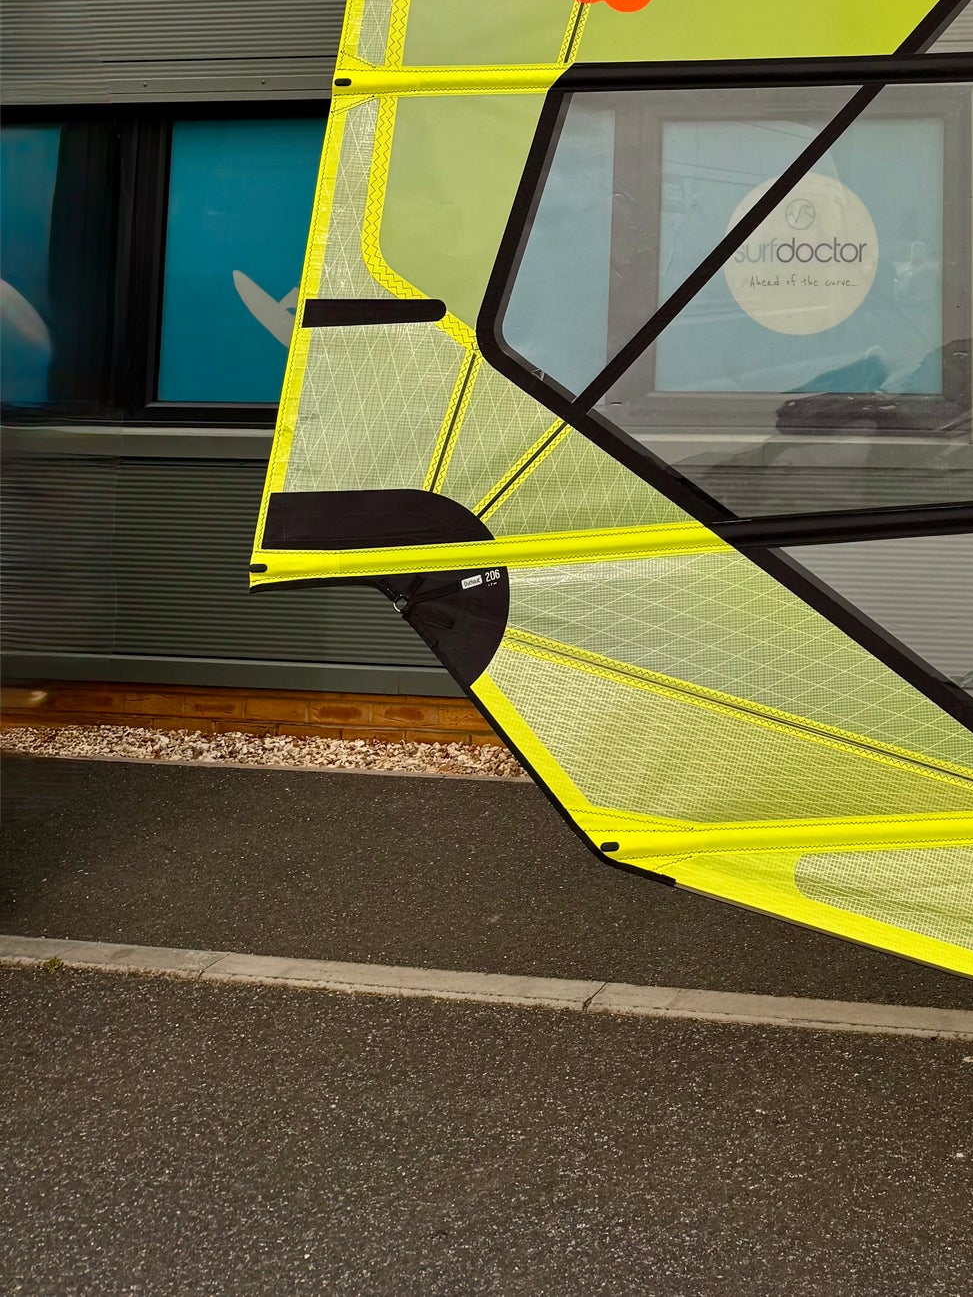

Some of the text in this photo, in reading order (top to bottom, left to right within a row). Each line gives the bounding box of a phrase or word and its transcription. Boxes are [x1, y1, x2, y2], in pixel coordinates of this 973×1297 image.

[733, 236, 868, 264] surfdoctor
[749, 274, 780, 288] Ahead
[786, 273, 797, 287] of
[801, 275, 819, 287] the
[485, 569, 500, 582] 206
